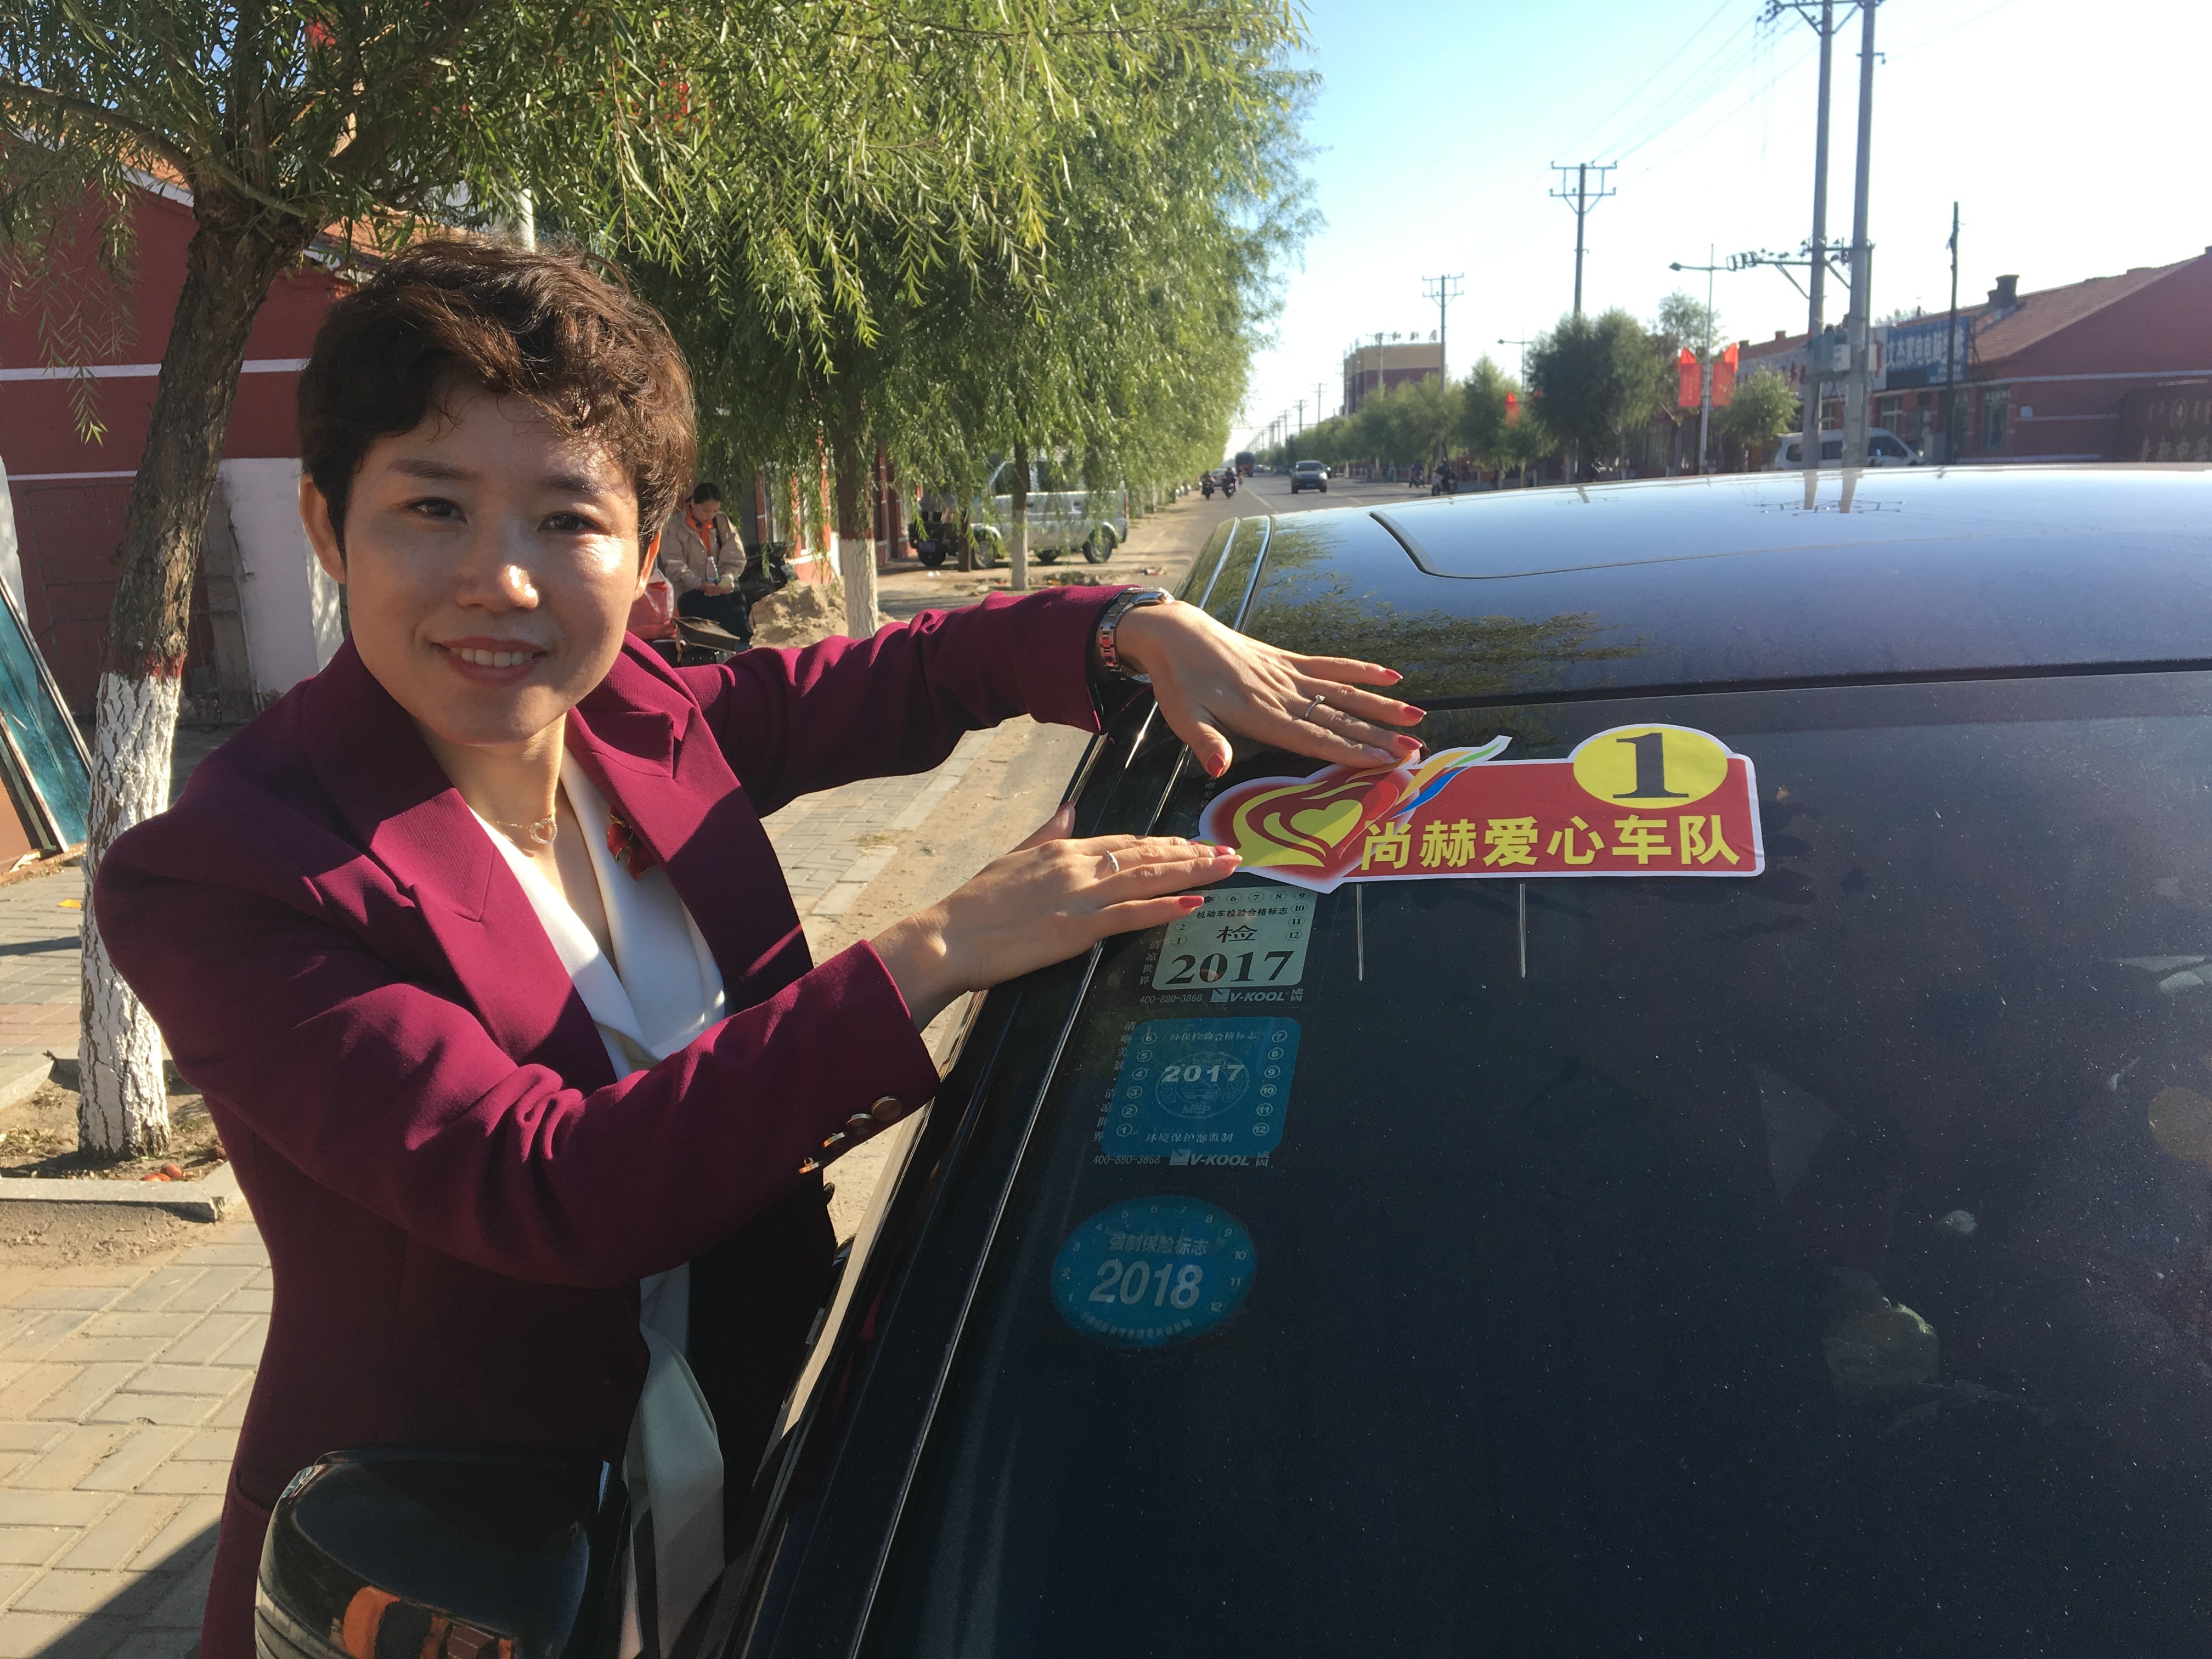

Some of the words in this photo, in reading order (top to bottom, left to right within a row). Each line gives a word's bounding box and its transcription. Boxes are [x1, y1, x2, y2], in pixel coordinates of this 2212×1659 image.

[1612, 732, 1689, 798] 1
[1361, 814, 1740, 871] 尚赫爱心车队
[1196, 907, 1288, 918] 机动车检验合格标志
[1216, 925, 1258, 943] 检
[1165, 950, 1295, 984] 2017
[1139, 994, 1202, 1004] 400-880-3868
[1230, 991, 1284, 1002] V-KOOL
[1161, 1064, 1245, 1082] 2017
[1182, 1104, 1212, 1114] MEP
[1092, 1155, 1161, 1164] 400-880-3868
[1190, 1154, 1250, 1166] V-KOOL
[1109, 1234, 1210, 1255] 强制保险标志
[1088, 1259, 1203, 1310] 2018
